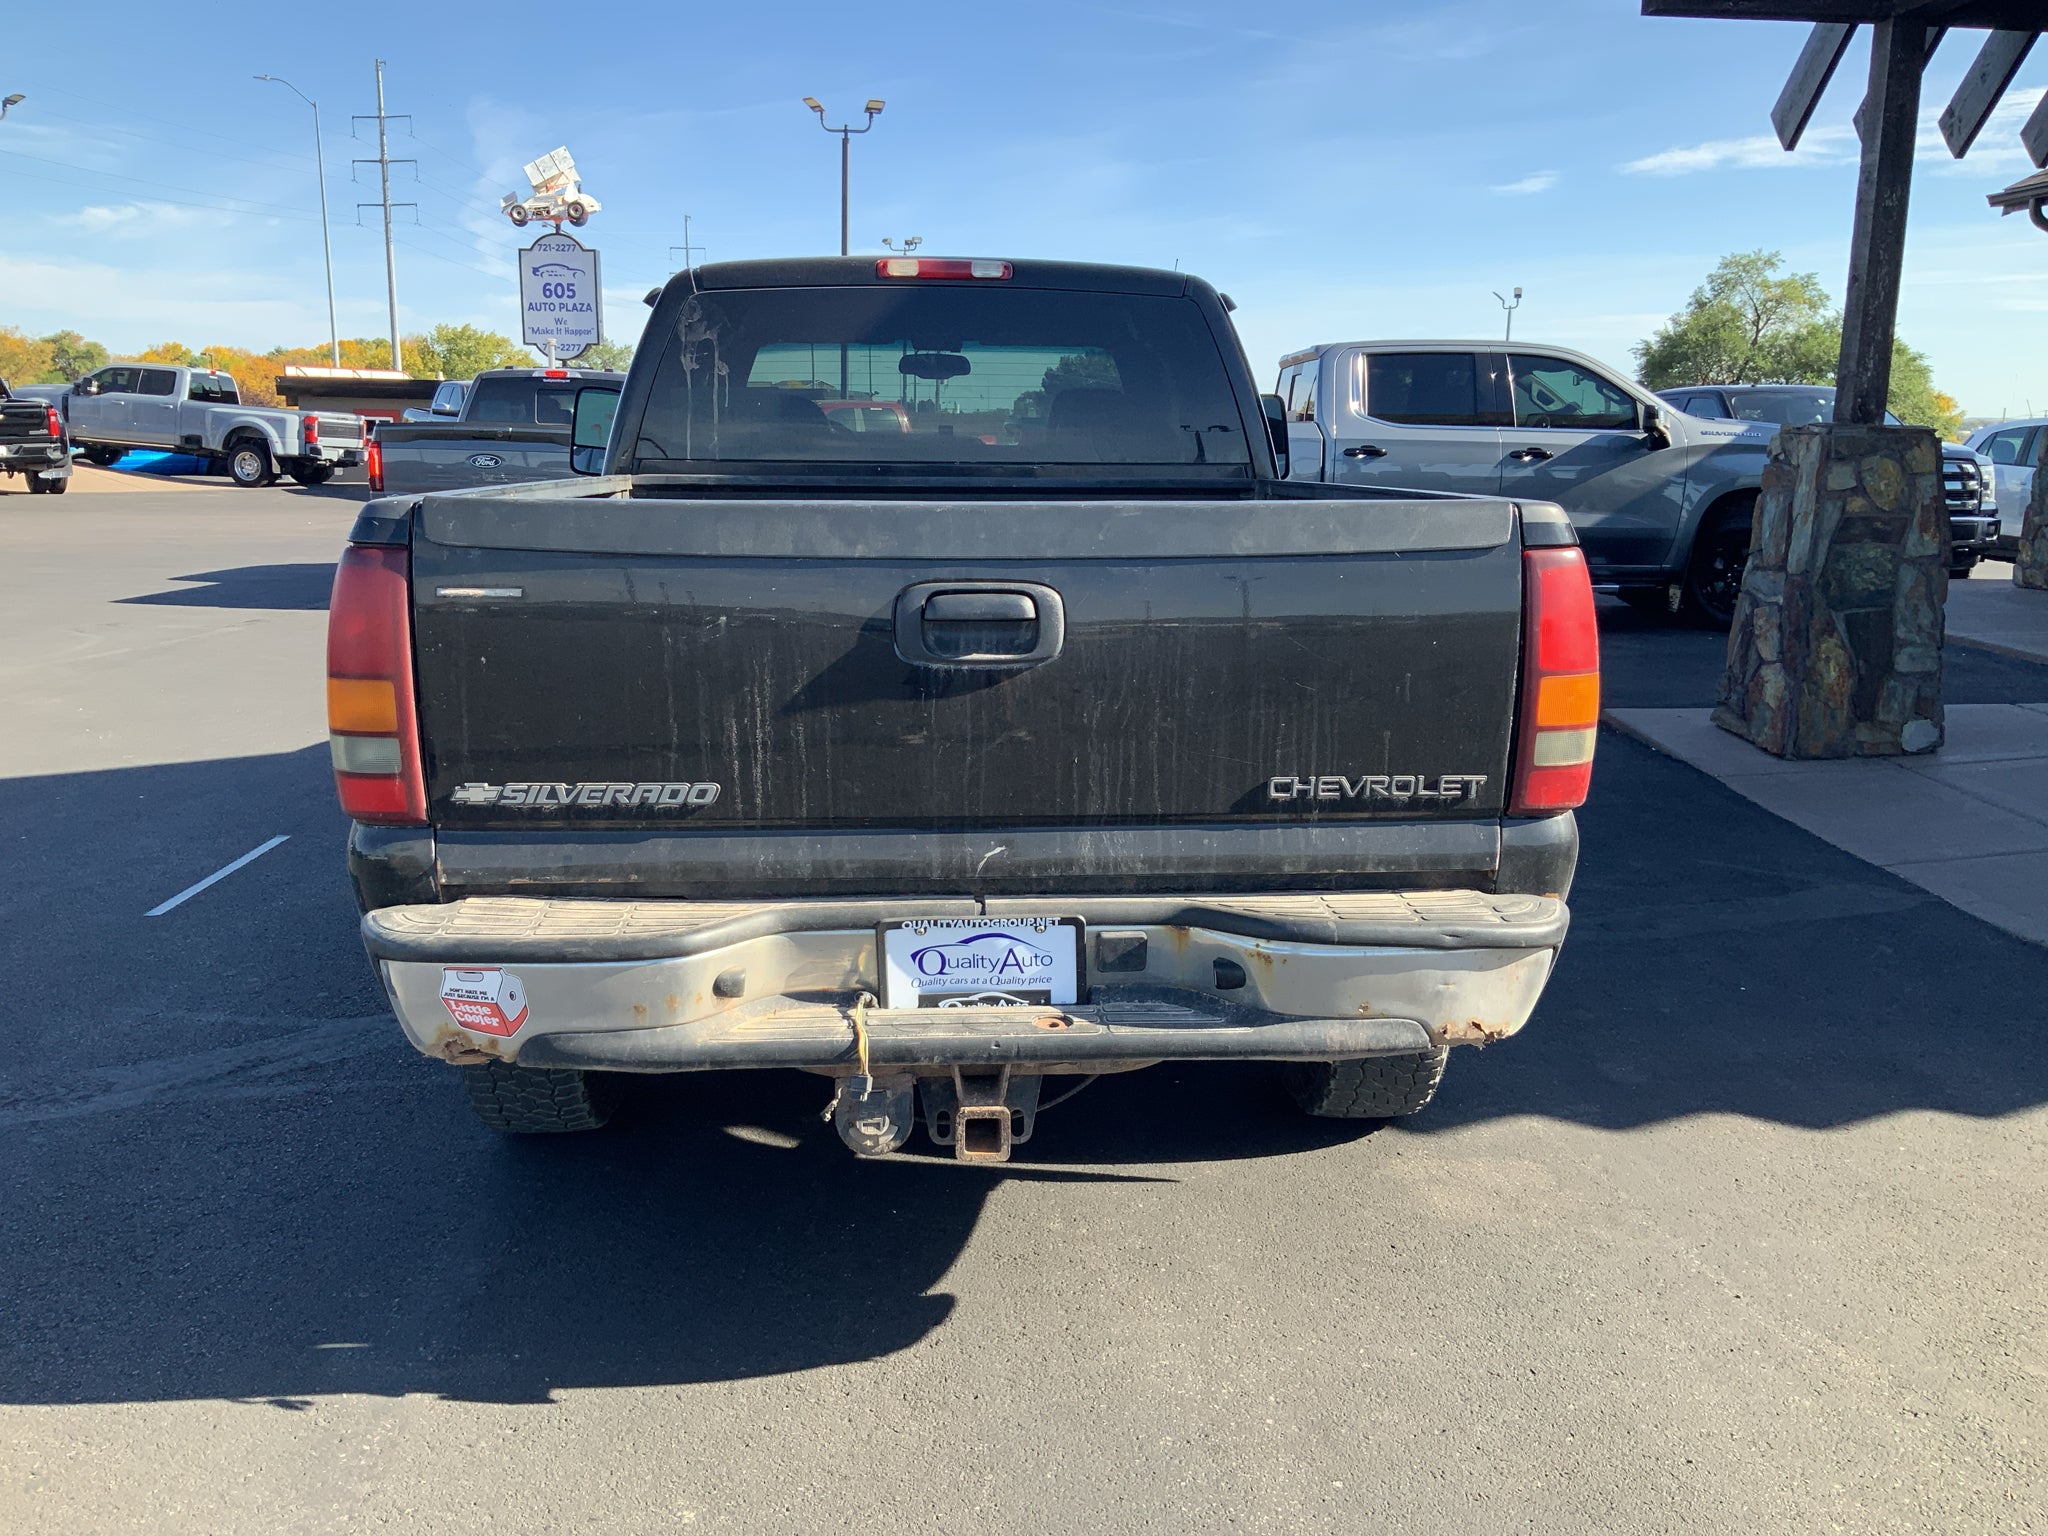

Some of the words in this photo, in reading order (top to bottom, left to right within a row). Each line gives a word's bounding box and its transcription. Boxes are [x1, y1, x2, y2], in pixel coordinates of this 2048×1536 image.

[538, 243, 576, 252] 721-2277
[542, 282, 576, 299] 605
[528, 302, 556, 312] AUTO
[558, 302, 593, 312] PLAZA
[554, 317, 568, 326] We
[556, 327, 562, 335] It
[543, 343, 581, 352] 71-2277
[475, 456, 496, 466] Ford
[1270, 775, 1488, 799] CHEVROLET
[500, 783, 721, 805] SILVERADO
[901, 917, 1061, 930] QUALITYAUTOGROUP.NET
[911, 975, 948, 989] Quality
[949, 976, 969, 986] cars
[970, 976, 980, 985] at
[989, 974, 1026, 987] Quality
[1028, 973, 1053, 985] price
[448, 1000, 492, 1015] Little
[454, 1011, 499, 1026] Cooler
